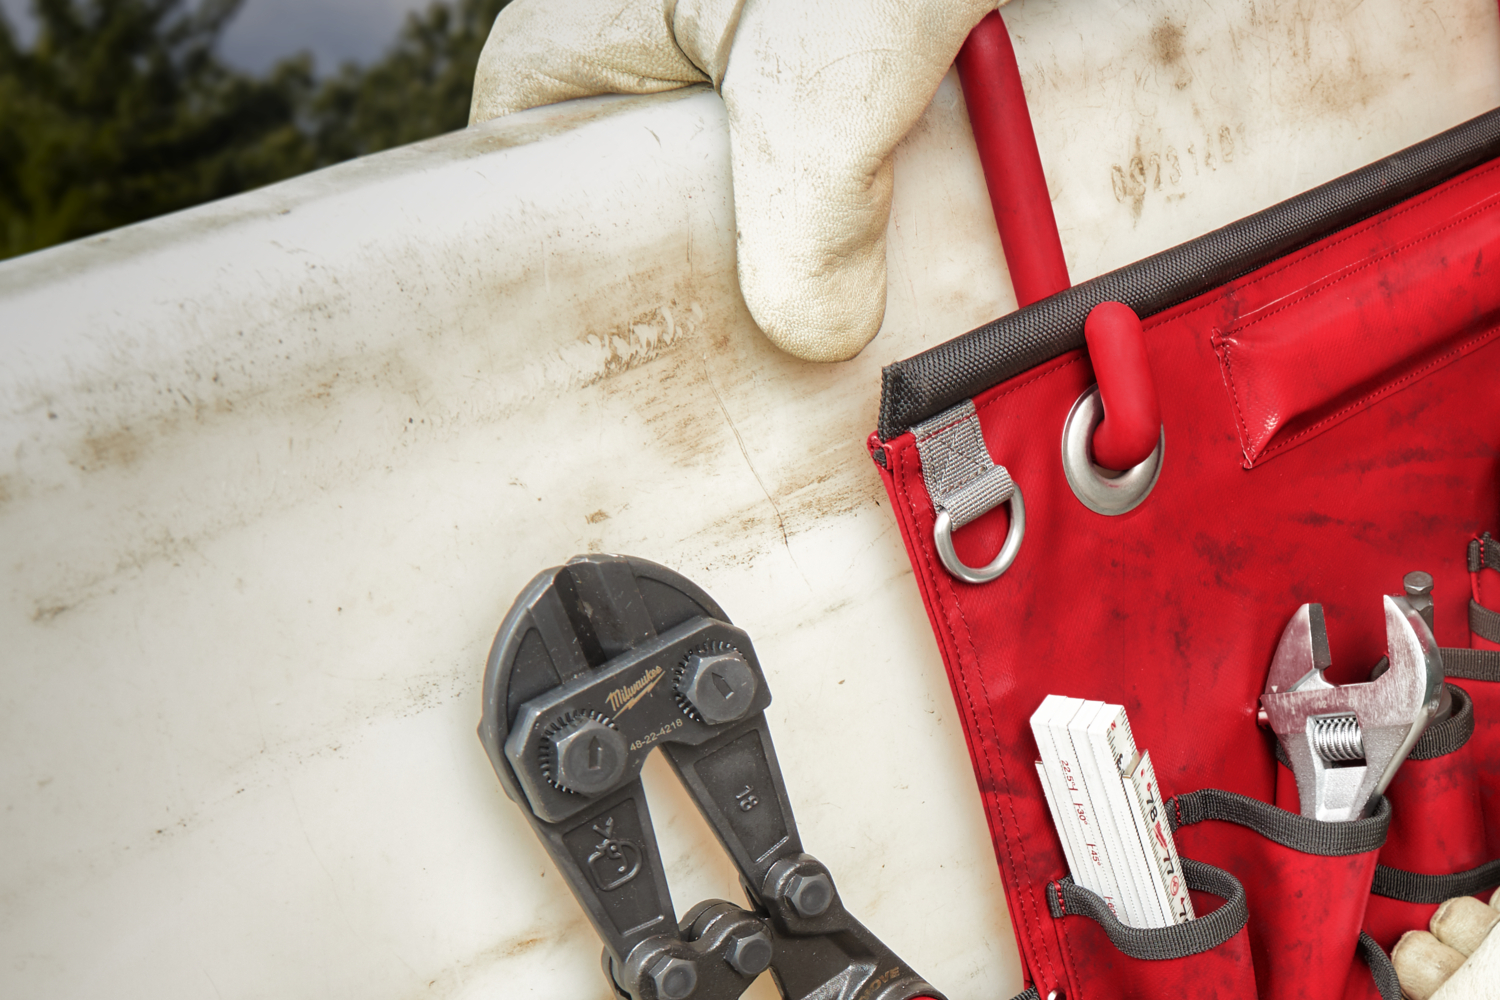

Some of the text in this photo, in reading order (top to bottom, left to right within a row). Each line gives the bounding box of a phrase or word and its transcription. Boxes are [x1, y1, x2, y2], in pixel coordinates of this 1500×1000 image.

[605, 665, 663, 711] Milwaukee
[630, 718, 683, 751] 48-22-4218
[735, 784, 759, 812] 18
[1146, 791, 1158, 822] 78
